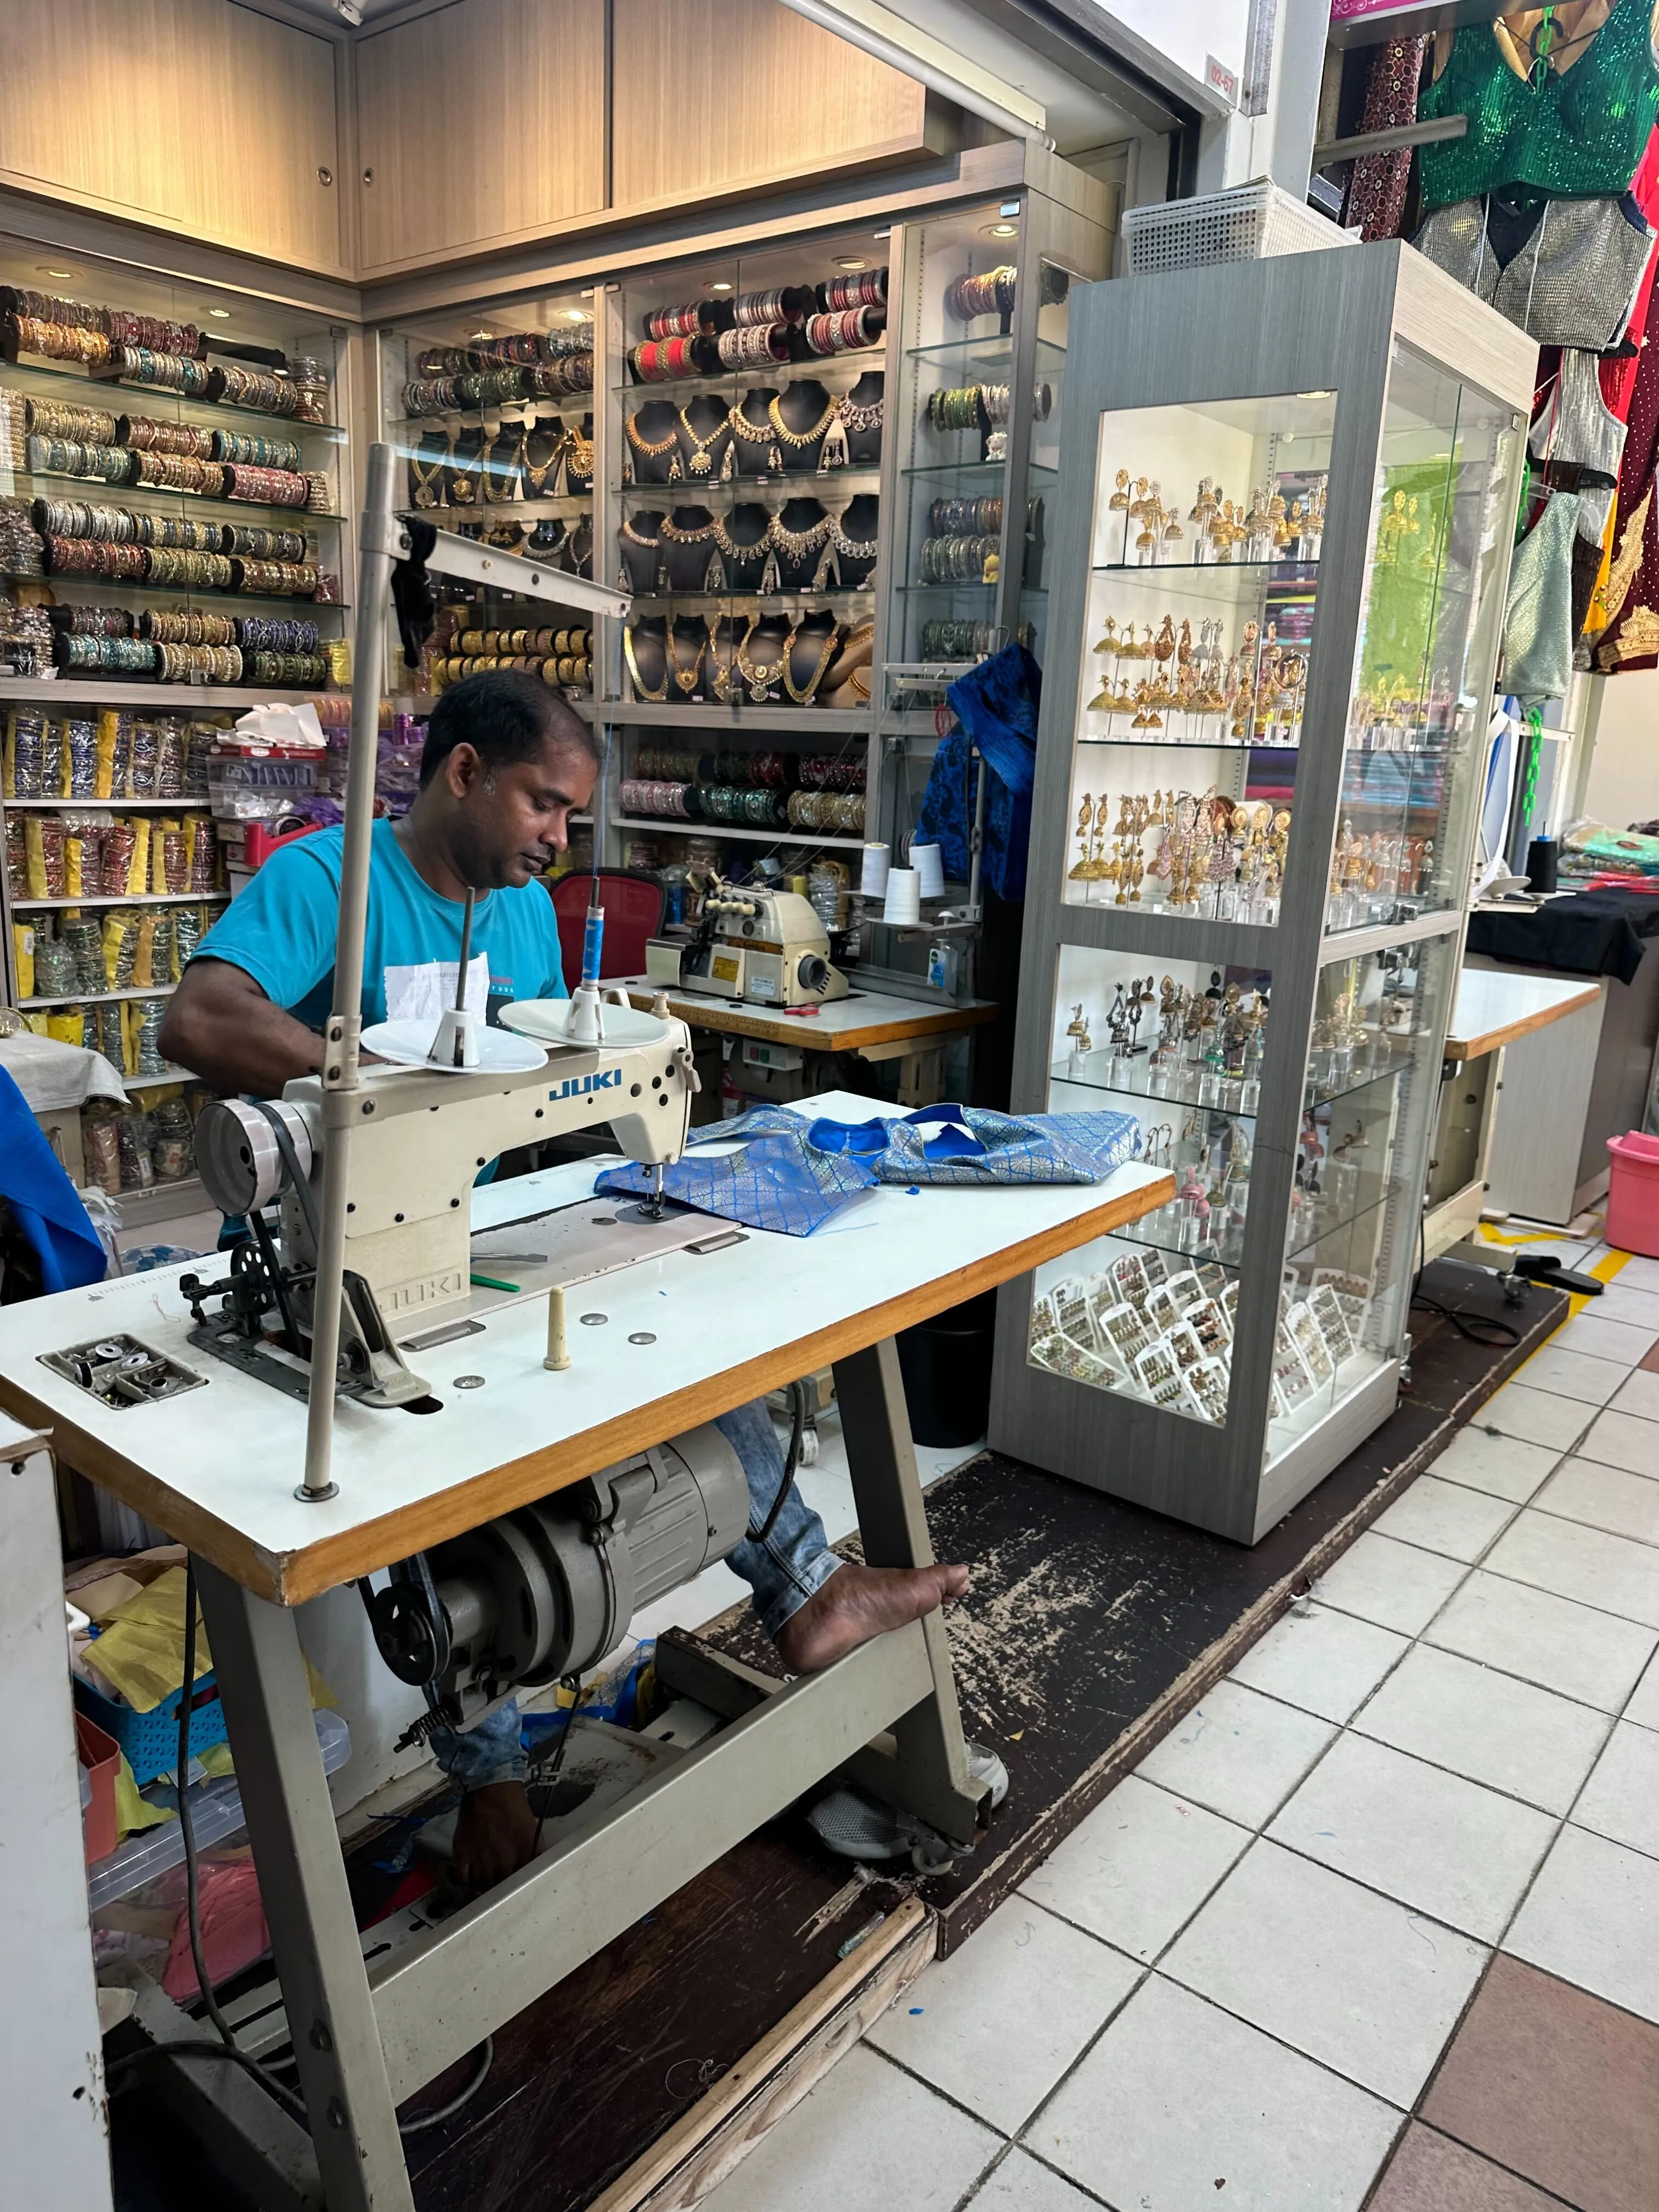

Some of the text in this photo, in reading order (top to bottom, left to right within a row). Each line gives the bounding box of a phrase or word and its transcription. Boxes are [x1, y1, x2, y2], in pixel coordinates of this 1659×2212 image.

[1211, 65, 1234, 94] 02-67
[549, 1069, 621, 1101] JUKI
[379, 1273, 461, 1314] JUKI
